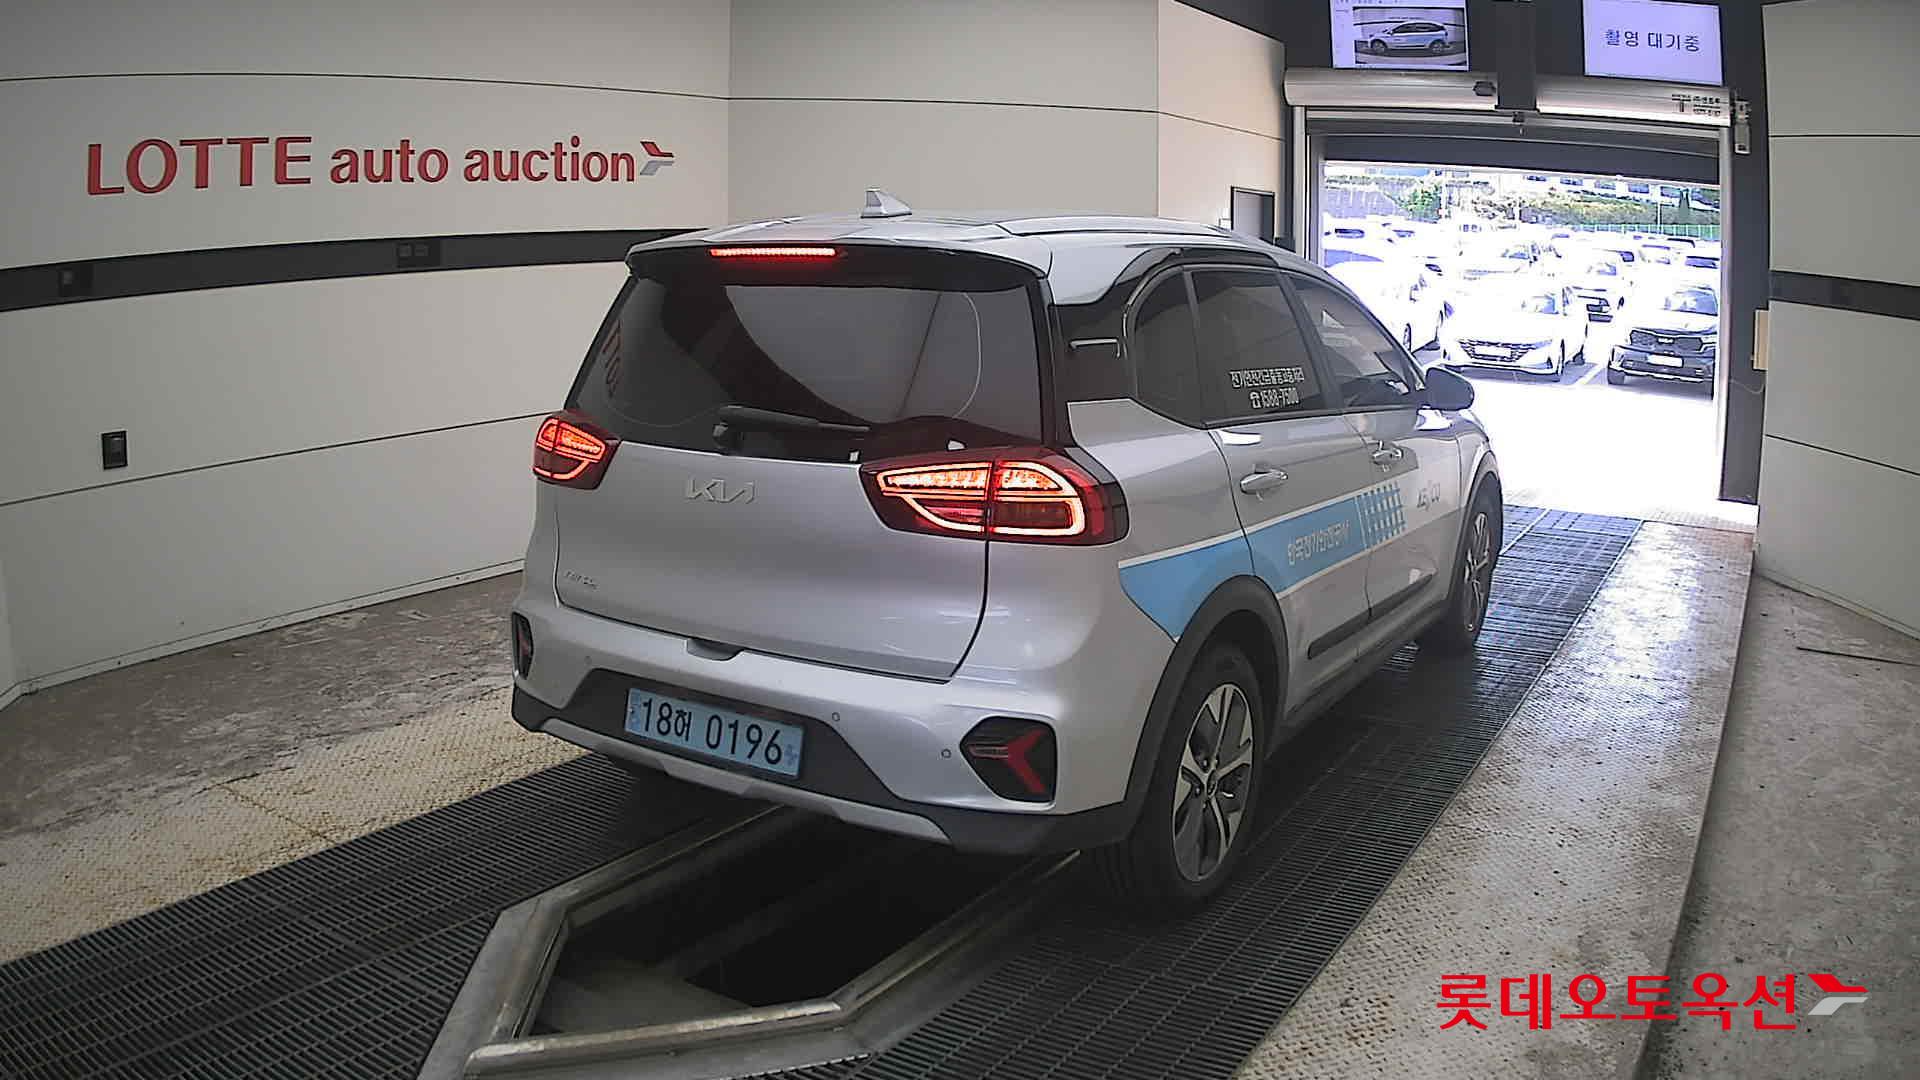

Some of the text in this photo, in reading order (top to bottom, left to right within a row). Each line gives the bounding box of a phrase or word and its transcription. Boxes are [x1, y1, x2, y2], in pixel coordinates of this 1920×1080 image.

[1605, 29, 1700, 52] 촬영 대기중
[86, 135, 636, 196] LOTTE auto auction
[686, 478, 756, 504] KIA
[705, 714, 782, 765] 0196
